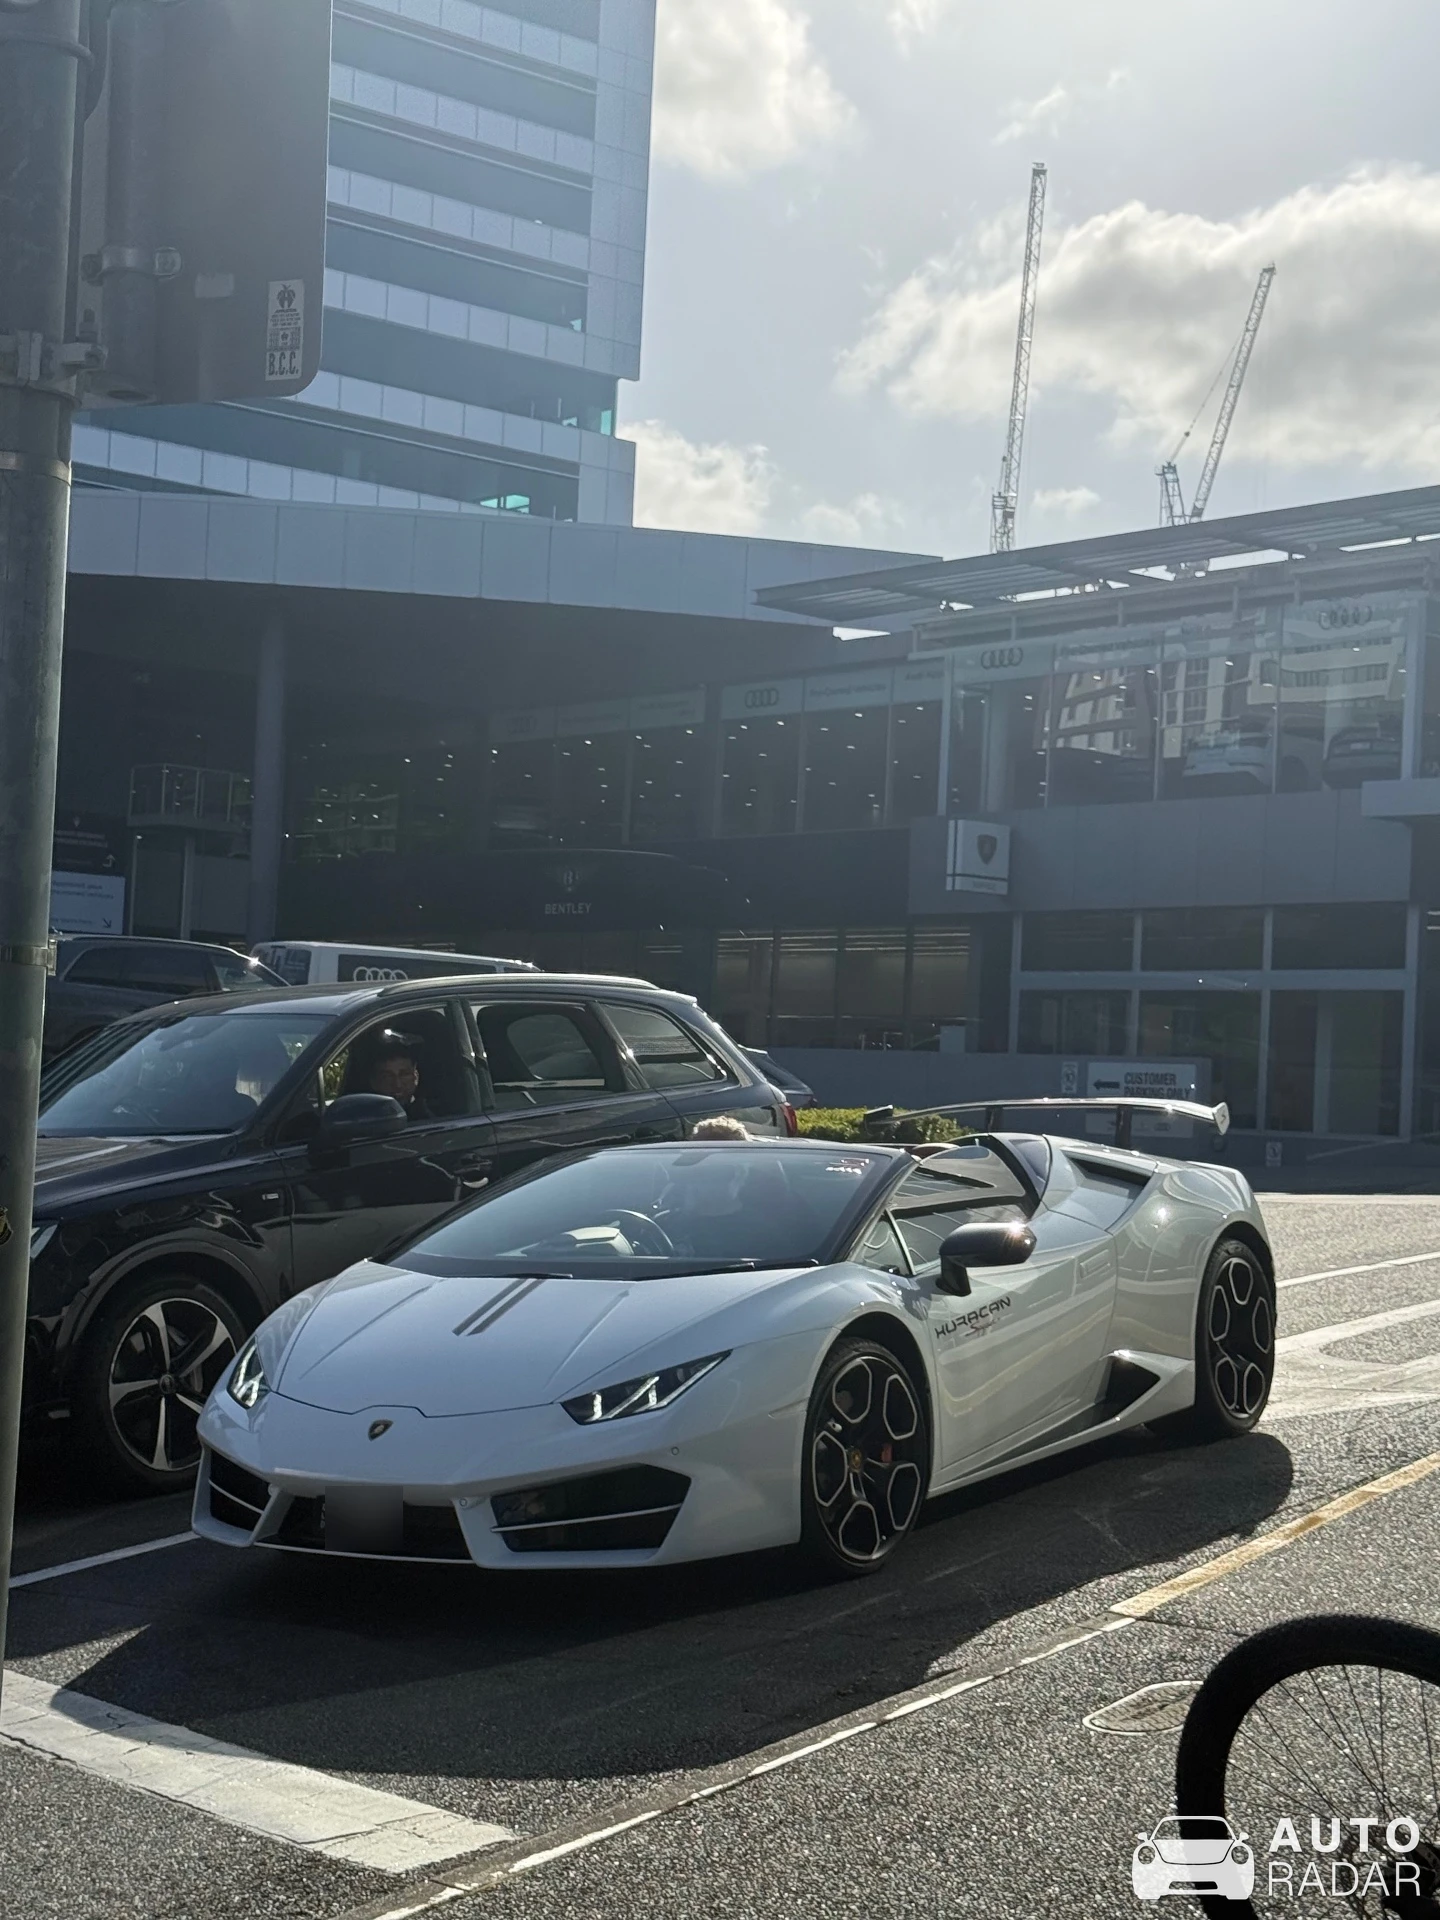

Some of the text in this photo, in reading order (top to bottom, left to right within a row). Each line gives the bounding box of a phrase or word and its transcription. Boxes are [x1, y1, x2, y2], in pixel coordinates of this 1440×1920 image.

[268, 351, 299, 375] B.C.C.
[545, 903, 592, 914] BENTLEY
[1124, 1072, 1176, 1086] CUSTOMER
[1124, 1086, 1191, 1099] PARKING ONLY
